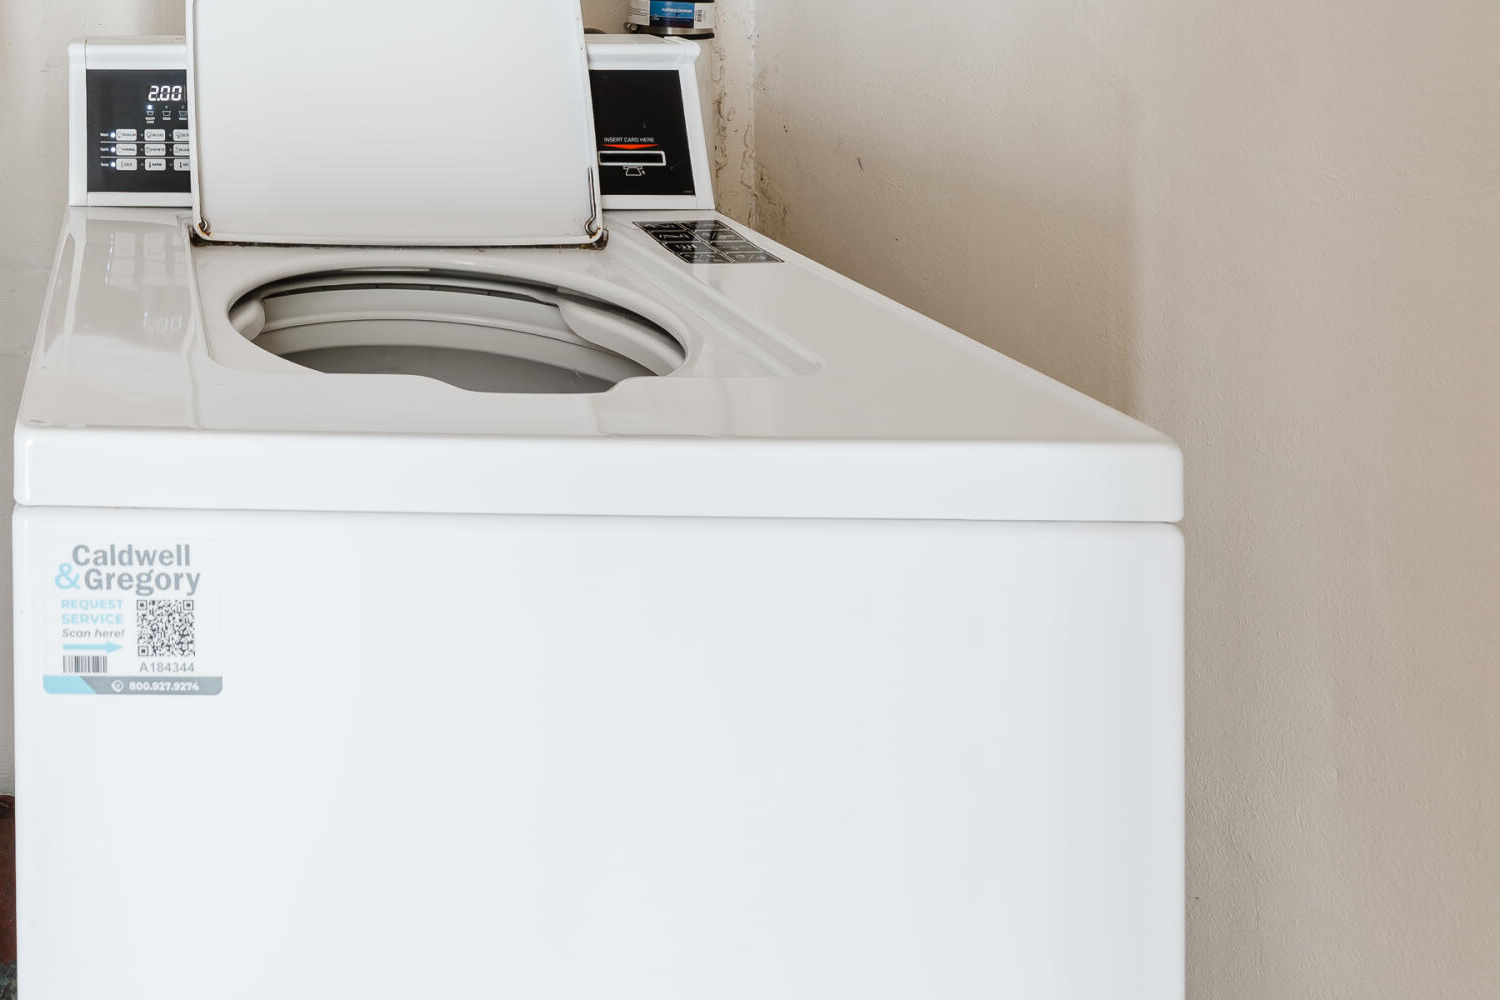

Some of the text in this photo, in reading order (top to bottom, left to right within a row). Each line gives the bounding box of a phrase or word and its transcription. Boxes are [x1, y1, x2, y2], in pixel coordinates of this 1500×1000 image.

[148, 85, 182, 102] 2.00
[72, 543, 190, 567] Caldwell
[61, 599, 125, 611] REQUEST
[61, 613, 125, 625] SERVICE
[62, 628, 125, 638] Scan here!
[139, 662, 195, 673] A184344
[129, 680, 200, 692] 800.927.9274
